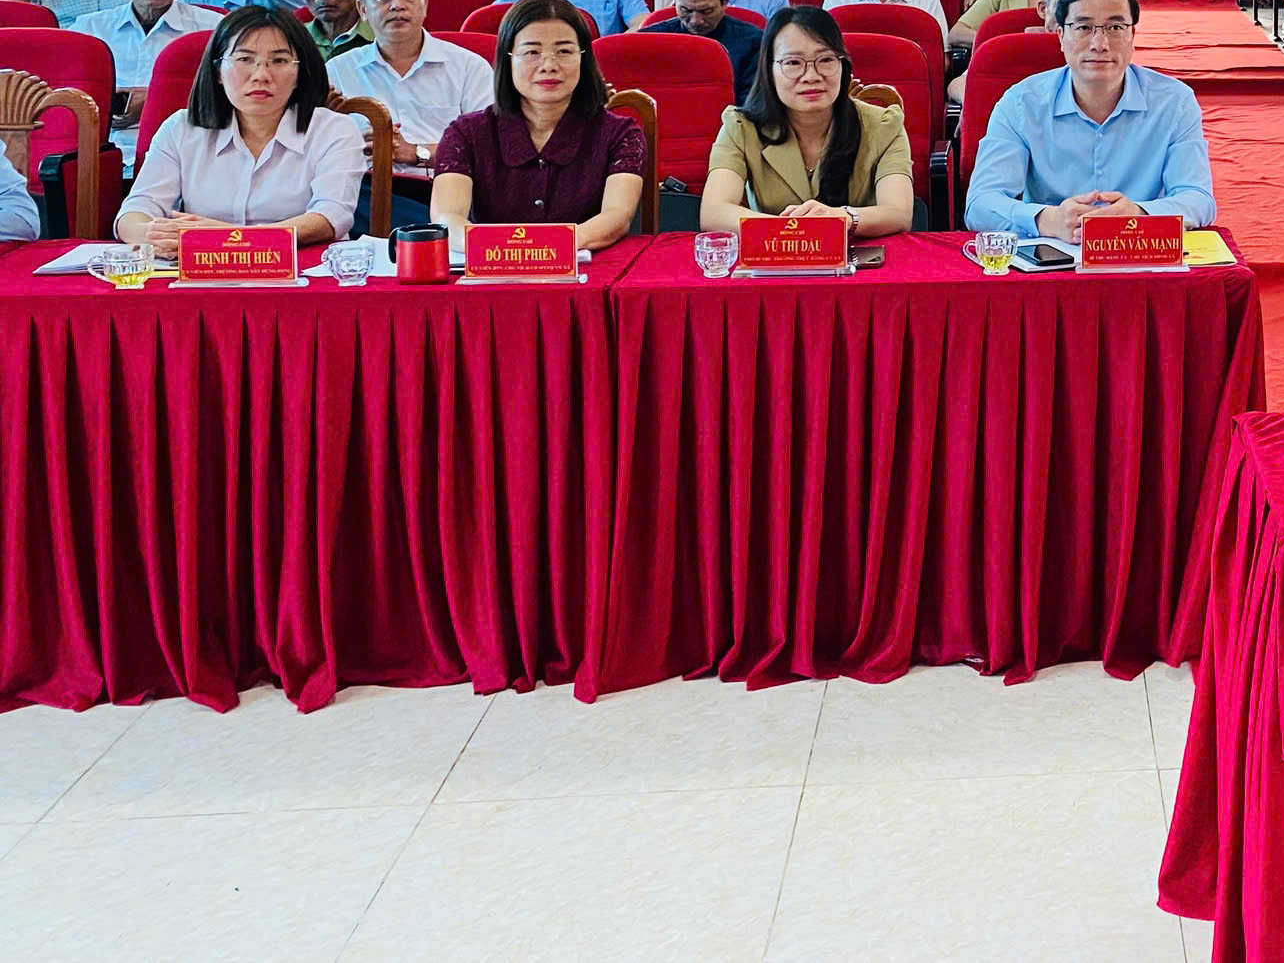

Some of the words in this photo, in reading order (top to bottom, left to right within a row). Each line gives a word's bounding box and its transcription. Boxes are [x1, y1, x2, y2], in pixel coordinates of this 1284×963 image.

[780, 240, 800, 255] THỊ
[1151, 238, 1179, 253] MẠNH
[193, 251, 228, 268] TRỊNH
[231, 251, 252, 267] THỊ
[503, 248, 522, 264] THỊ
